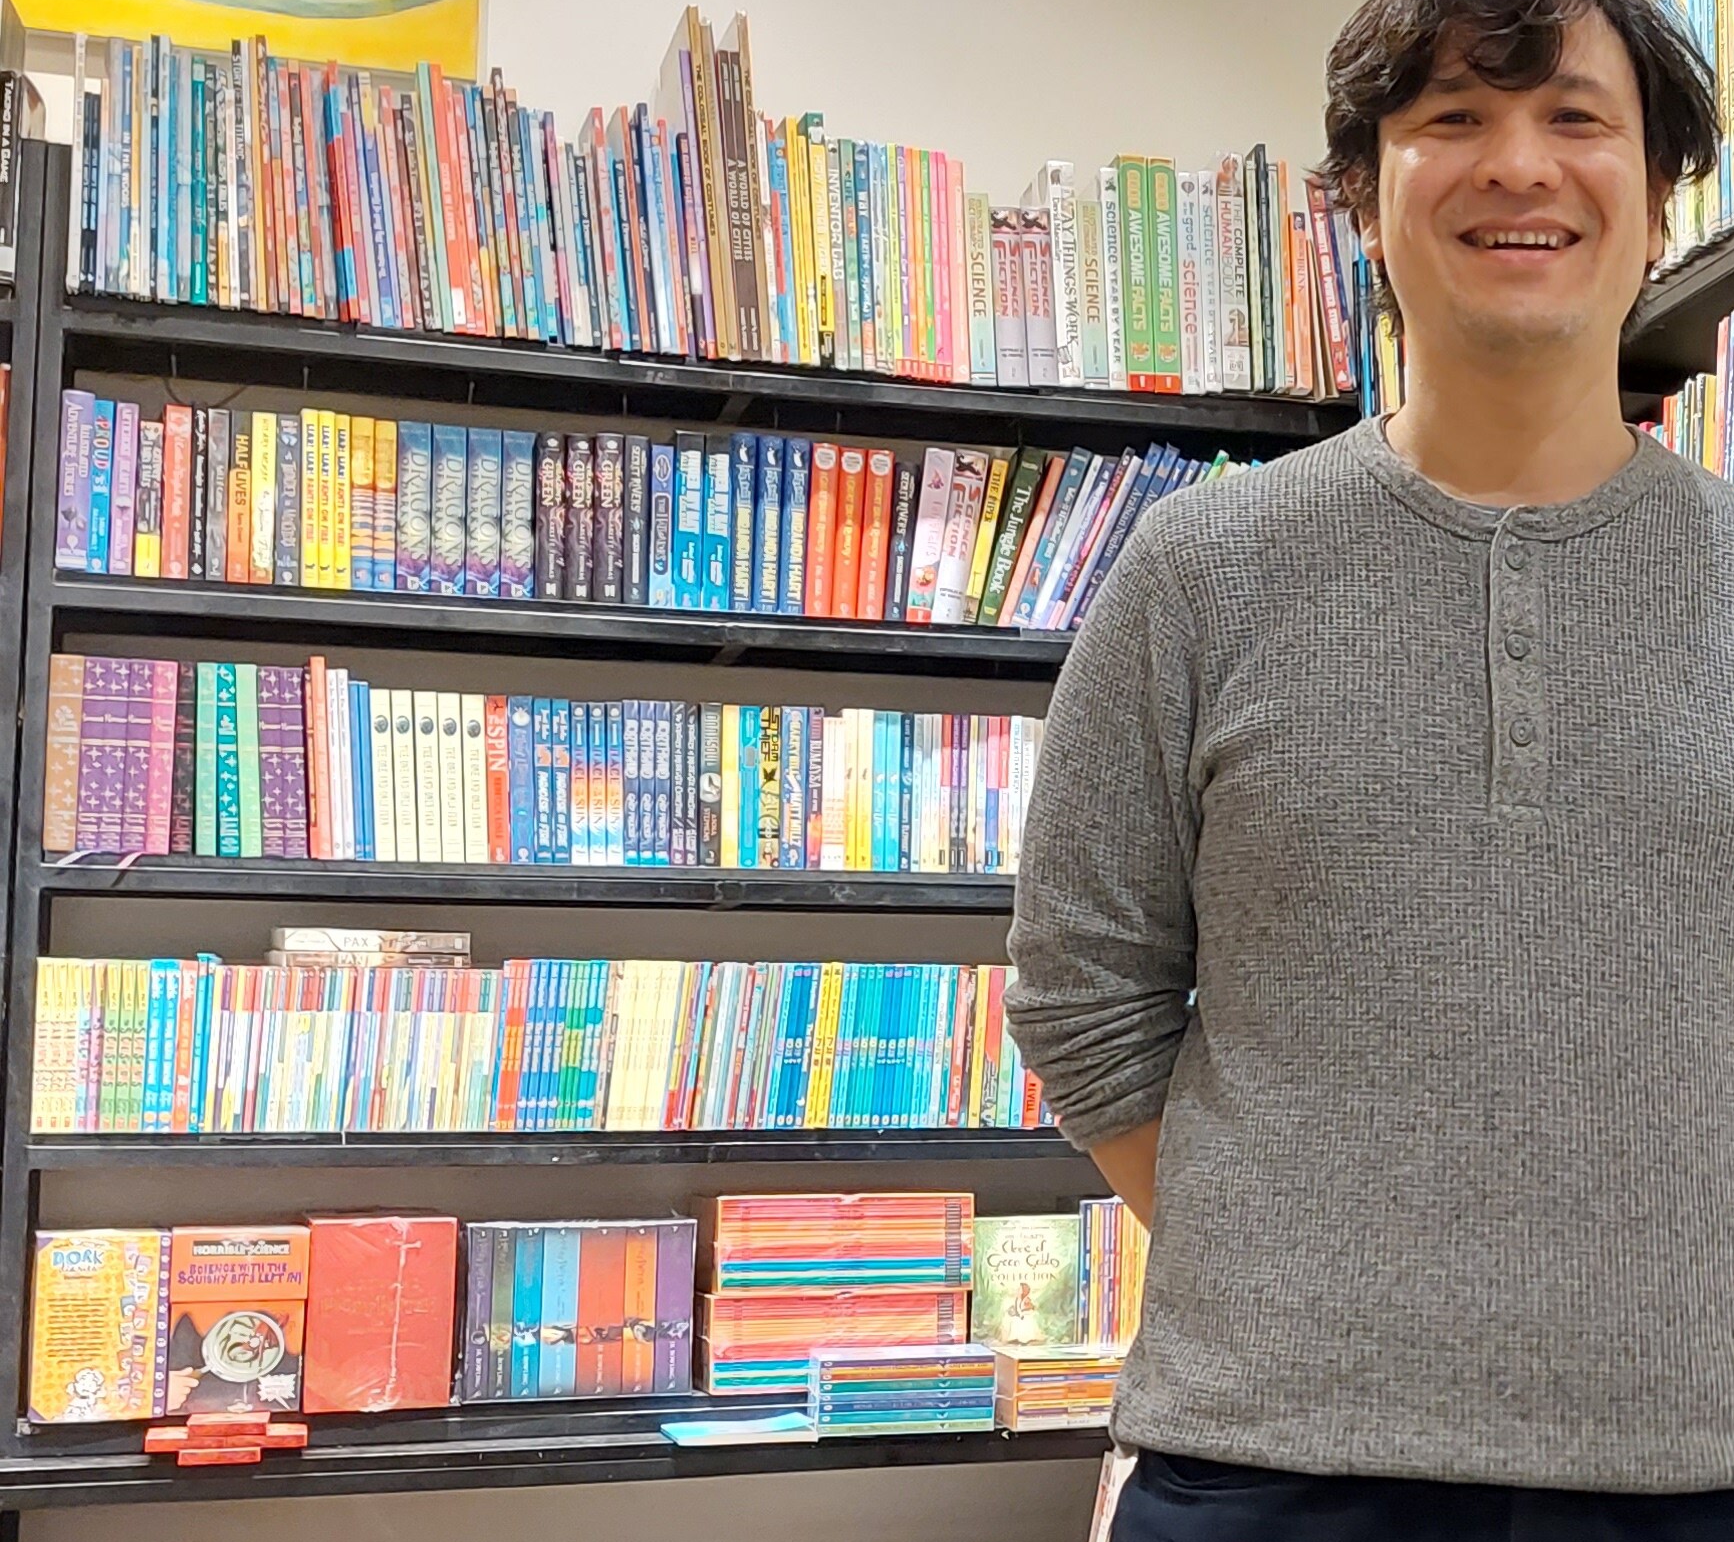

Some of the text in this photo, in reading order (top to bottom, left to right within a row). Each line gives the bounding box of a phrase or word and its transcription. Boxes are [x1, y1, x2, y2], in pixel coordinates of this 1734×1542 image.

[701, 138, 711, 162] BOOK
[749, 143, 758, 166] BOOK
[728, 169, 740, 207] WORLD
[737, 171, 750, 209] WORLD
[731, 210, 741, 225] OF
[732, 226, 742, 261] CITIES
[741, 212, 751, 226] OF
[829, 168, 844, 281] INVENTOR LAB
[1105, 200, 1119, 264] science
[1203, 205, 1217, 266] science
[742, 228, 753, 262] CITIES
[1128, 209, 1147, 332] AWESOME FACTS
[1155, 210, 1173, 332] AWESOME FACTS
[1232, 202, 1244, 298] THE COMPLETE
[971, 251, 987, 318] SCIENCE
[993, 240, 1020, 318] SCIENCE FICTION
[1023, 240, 1050, 318] SCIENCE FICTION
[1061, 238, 1079, 347] THINGS WORK
[1084, 257, 1100, 324] SCIENCE
[1109, 269, 1119, 305] YEAR
[1182, 217, 1198, 335] good science
[1113, 330, 1122, 364] YEAR
[64, 400, 82, 497] ADVENTURE STORIES
[94, 416, 110, 469] PROUD
[235, 434, 249, 506] HALF LIVES
[542, 458, 554, 507] GREEN
[572, 460, 584, 508] GREEN
[601, 459, 613, 508] GREEN
[629, 477, 642, 513] RIVERS
[410, 450, 429, 561] DRAGONS
[444, 456, 464, 567] DRAGONS
[479, 457, 499, 567] DRAGONS
[515, 460, 532, 569] DRAGONS
[896, 471, 910, 535] SECRET RIVERS
[949, 483, 967, 558] FICTION
[983, 472, 1003, 523] THE PIPER
[1116, 488, 1143, 527] Arabian
[958, 486, 981, 562] SCIENCE
[988, 485, 1032, 595] The Jungle Book
[734, 507, 751, 597] MIRANDA HART
[761, 508, 777, 599] MIRANDA HART
[787, 510, 803, 601] MIRANDA HART
[487, 726, 505, 772] SPIN
[760, 710, 771, 762] THIEF
[771, 710, 779, 762] STORM
[809, 740, 821, 788] RUMAYSA
[343, 937, 369, 947] PAX
[1026, 1083, 1036, 1113] REVELL
[53, 1250, 104, 1266] DORK
[238, 1263, 265, 1273] WITH
[268, 1262, 288, 1272] THE
[987, 1254, 1020, 1272] Green
[991, 1273, 1057, 1281] COLLECTION
